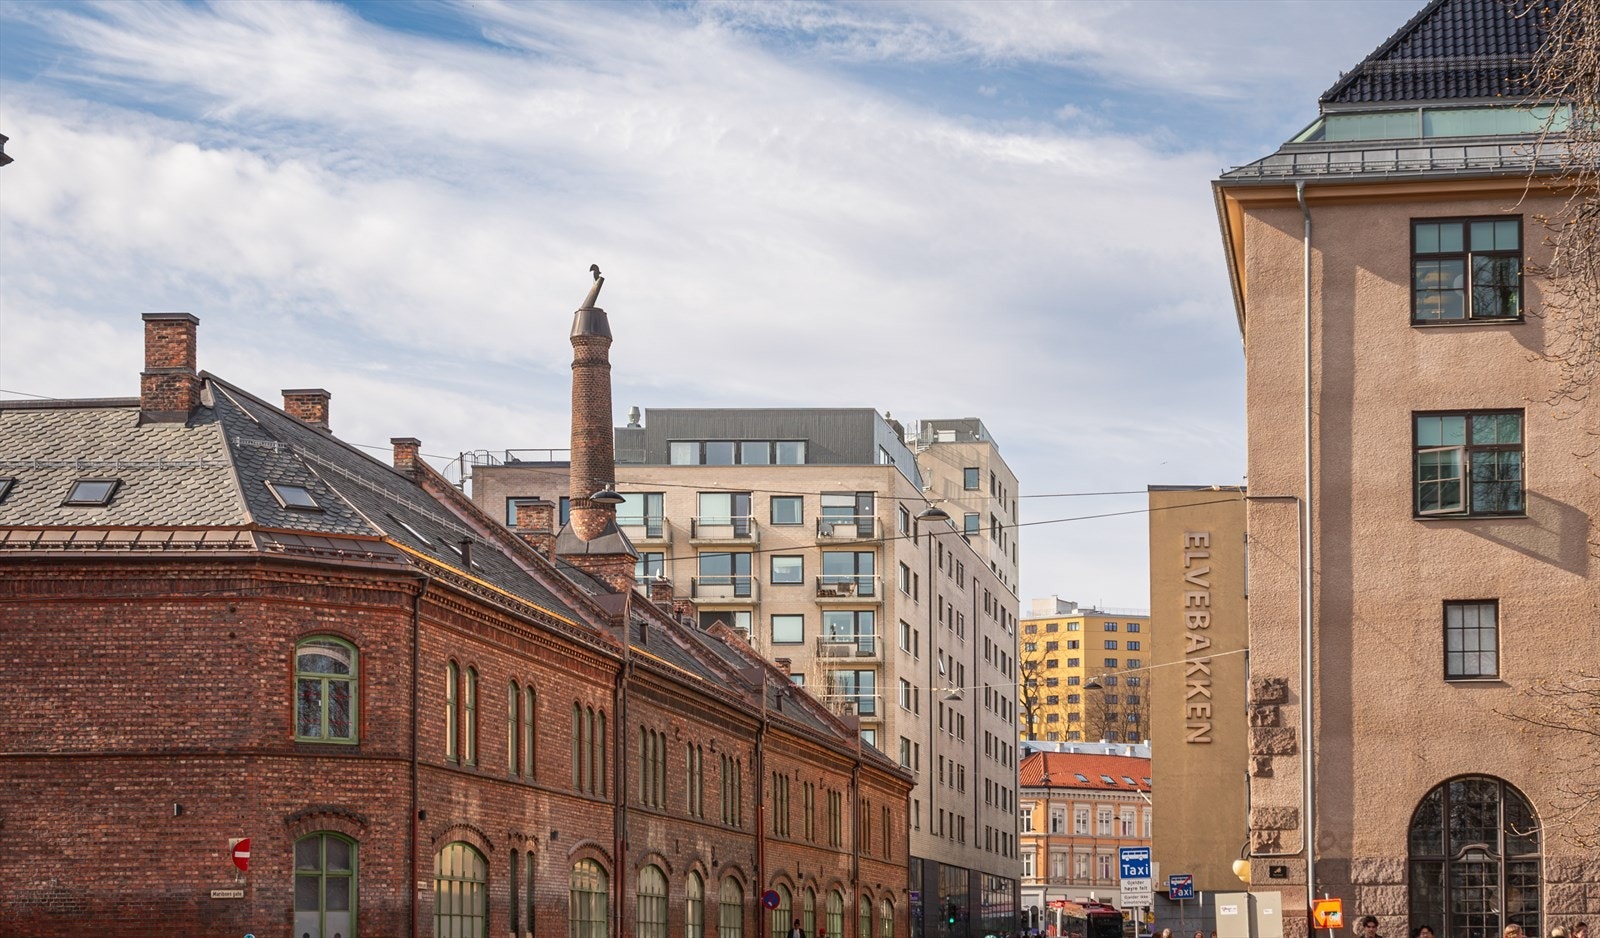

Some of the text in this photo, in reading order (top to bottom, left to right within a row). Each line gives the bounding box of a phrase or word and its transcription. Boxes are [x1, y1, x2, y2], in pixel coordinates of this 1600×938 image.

[1184, 531, 1213, 744] ELVEBAKKEN
[1122, 864, 1149, 876] Taxi
[1172, 887, 1192, 897] Taxi
